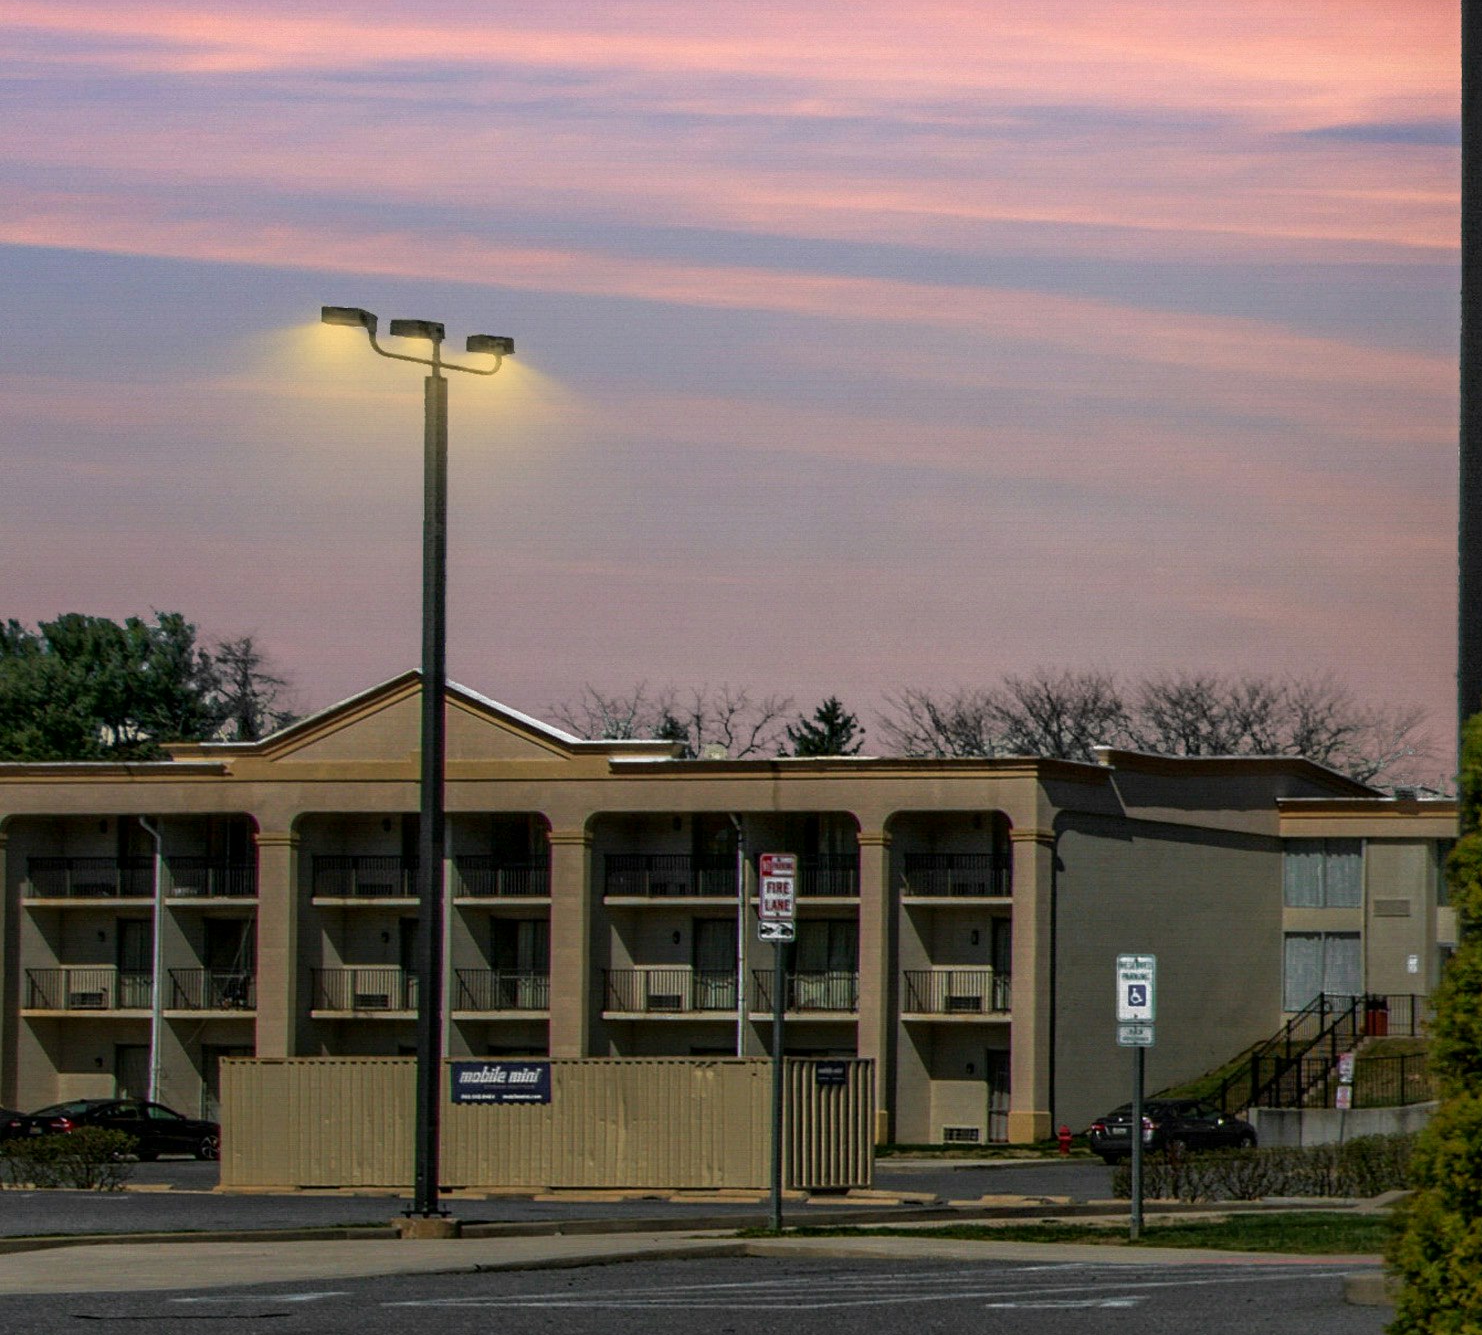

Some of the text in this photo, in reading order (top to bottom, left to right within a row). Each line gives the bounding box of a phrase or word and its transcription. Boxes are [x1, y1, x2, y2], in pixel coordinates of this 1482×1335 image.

[766, 881, 790, 894] FIRE
[765, 899, 790, 912] LANE
[459, 1066, 542, 1083] mobile mini
